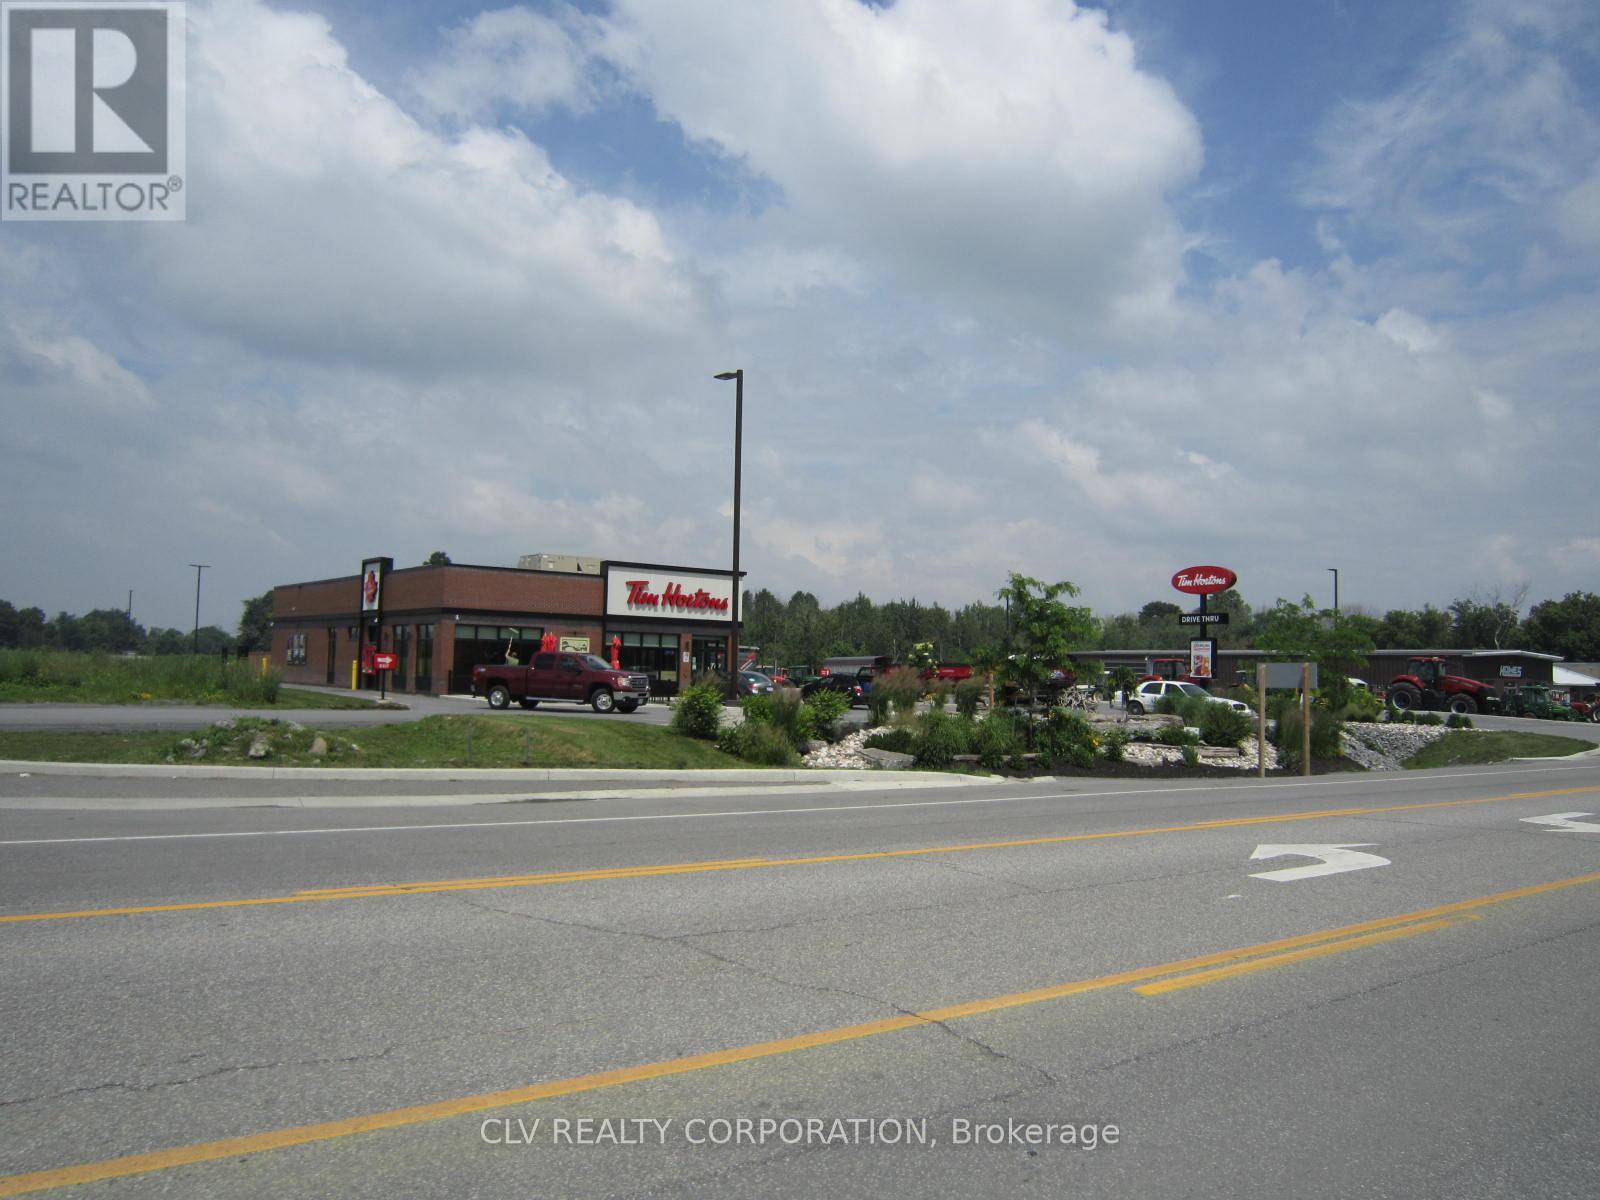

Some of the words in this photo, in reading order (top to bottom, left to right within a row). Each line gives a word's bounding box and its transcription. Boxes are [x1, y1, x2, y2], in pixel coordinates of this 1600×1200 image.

[1177, 574, 1192, 587] Tim
[1193, 573, 1226, 587] Hortons
[625, 580, 660, 606] Tim
[661, 581, 729, 610] Hortons
[1181, 615, 1200, 623] DRIVE
[1201, 615, 1220, 623] THRU
